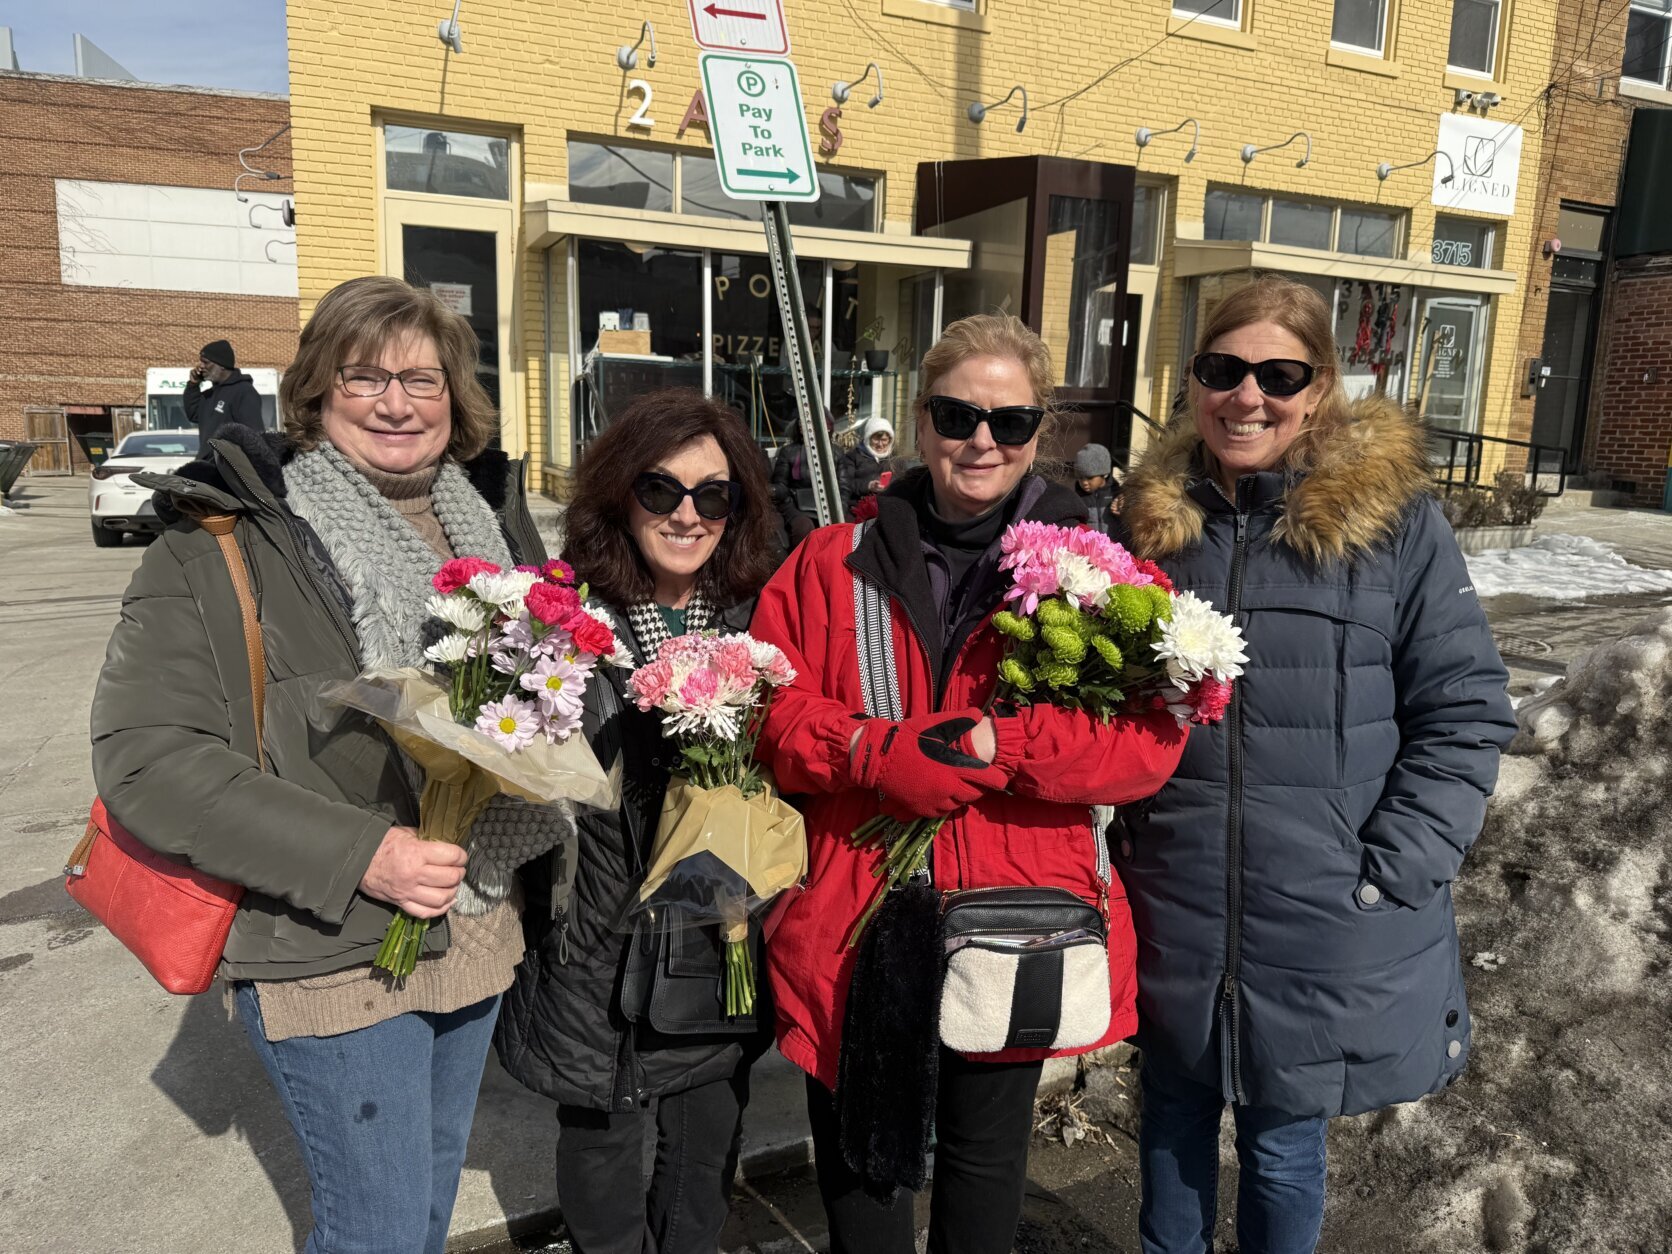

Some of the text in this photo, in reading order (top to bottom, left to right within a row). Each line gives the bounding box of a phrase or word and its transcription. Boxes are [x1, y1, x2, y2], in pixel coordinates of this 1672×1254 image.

[745, 75, 758, 91] P
[738, 103, 773, 122] Pay
[749, 125, 773, 140] To
[741, 142, 785, 158] Park
[1432, 240, 1472, 266] 3715
[712, 333, 824, 360] PIZZEA
